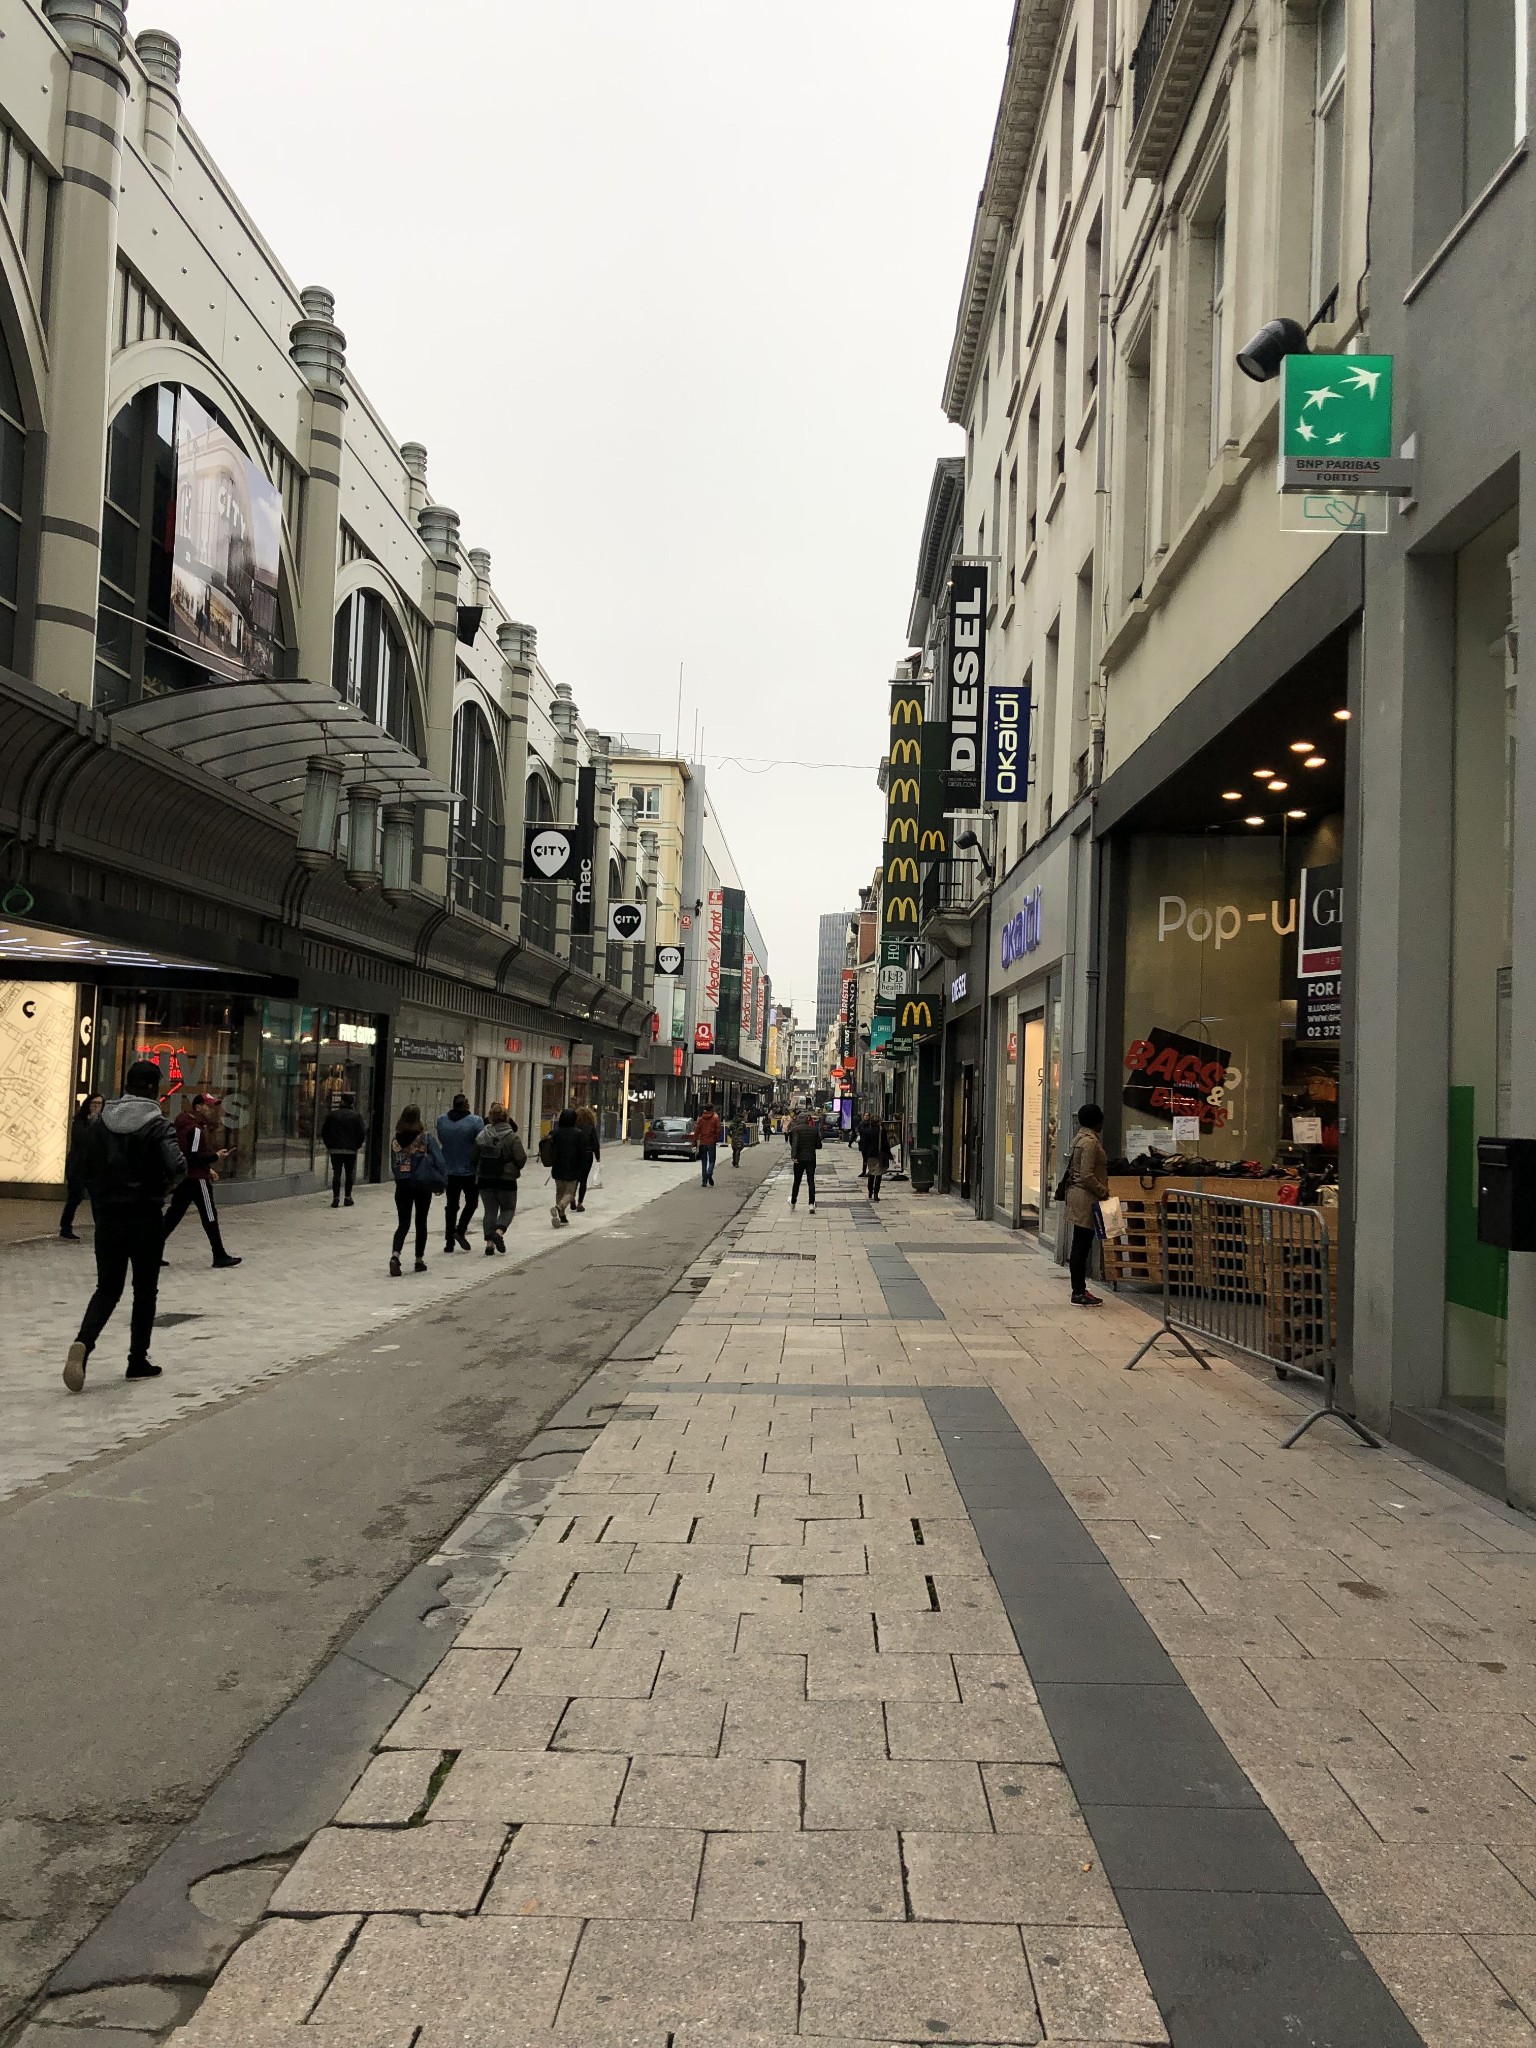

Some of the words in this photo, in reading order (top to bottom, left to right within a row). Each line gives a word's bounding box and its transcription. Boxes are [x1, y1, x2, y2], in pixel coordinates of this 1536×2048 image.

[1297, 459, 1324, 469] BNP
[1326, 460, 1380, 471] PARIBAS
[1317, 473, 1360, 482] FORTIS
[950, 587, 981, 772] DIESEL
[533, 845, 567, 858] CITY
[575, 858, 592, 904] fnac
[614, 915, 640, 925] CITY
[1158, 895, 1297, 950] Pop-u
[842, 978, 851, 1014] BRISTOL
[1307, 982, 1335, 997] FOR
[339, 1024, 356, 1042] FIVE
[357, 1026, 376, 1045] GUYS
[1306, 1027, 1321, 1037] 02
[1323, 1025, 1341, 1037] 373
[1124, 1039, 1226, 1094] BAGS
